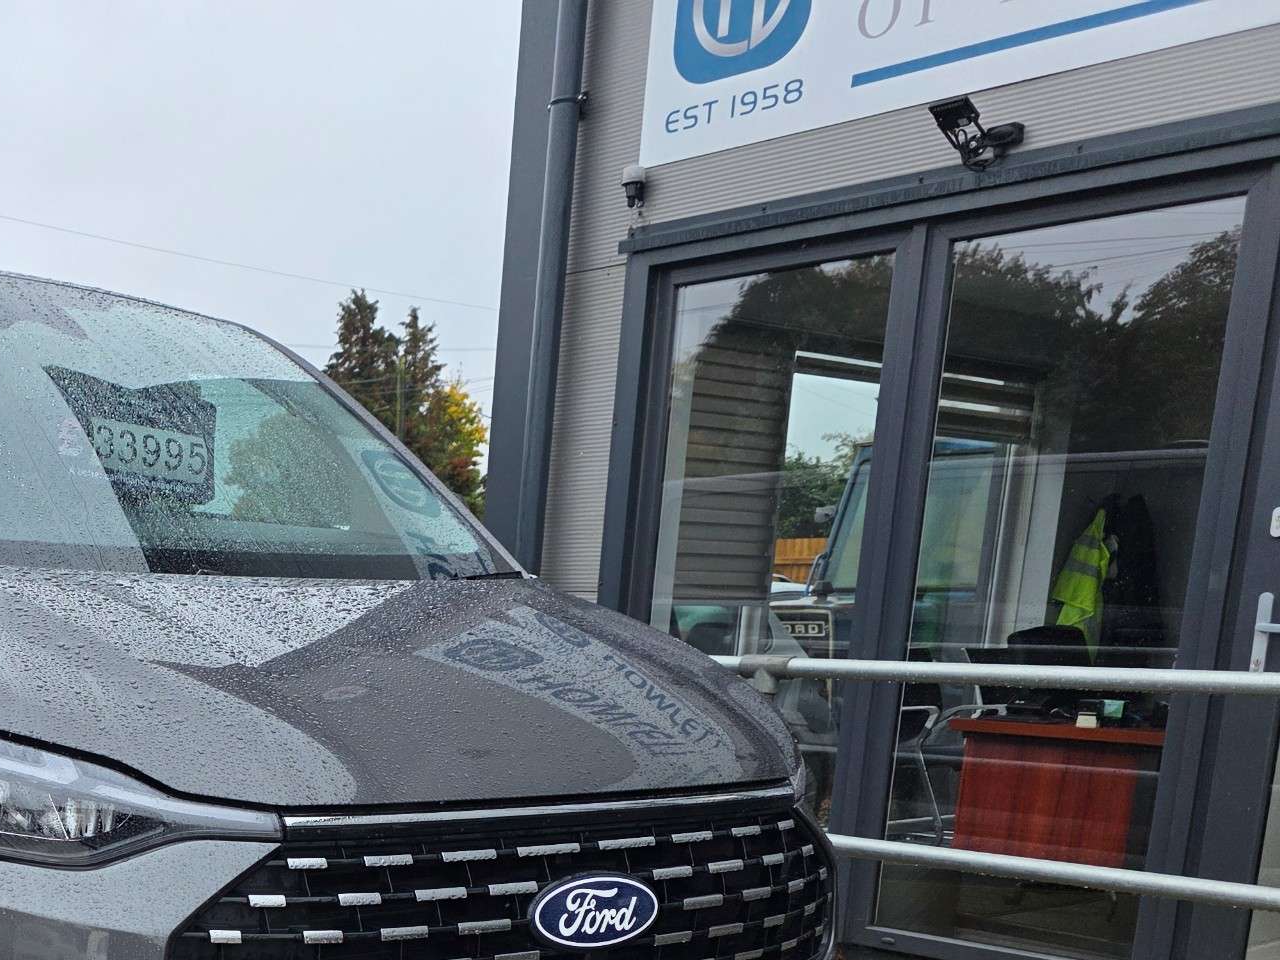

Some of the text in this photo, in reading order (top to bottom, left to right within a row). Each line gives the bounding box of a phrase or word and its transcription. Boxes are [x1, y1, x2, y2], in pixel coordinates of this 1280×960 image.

[665, 78, 804, 133] EST 1958
[95, 424, 207, 476] 33995
[558, 887, 638, 937] Ford
